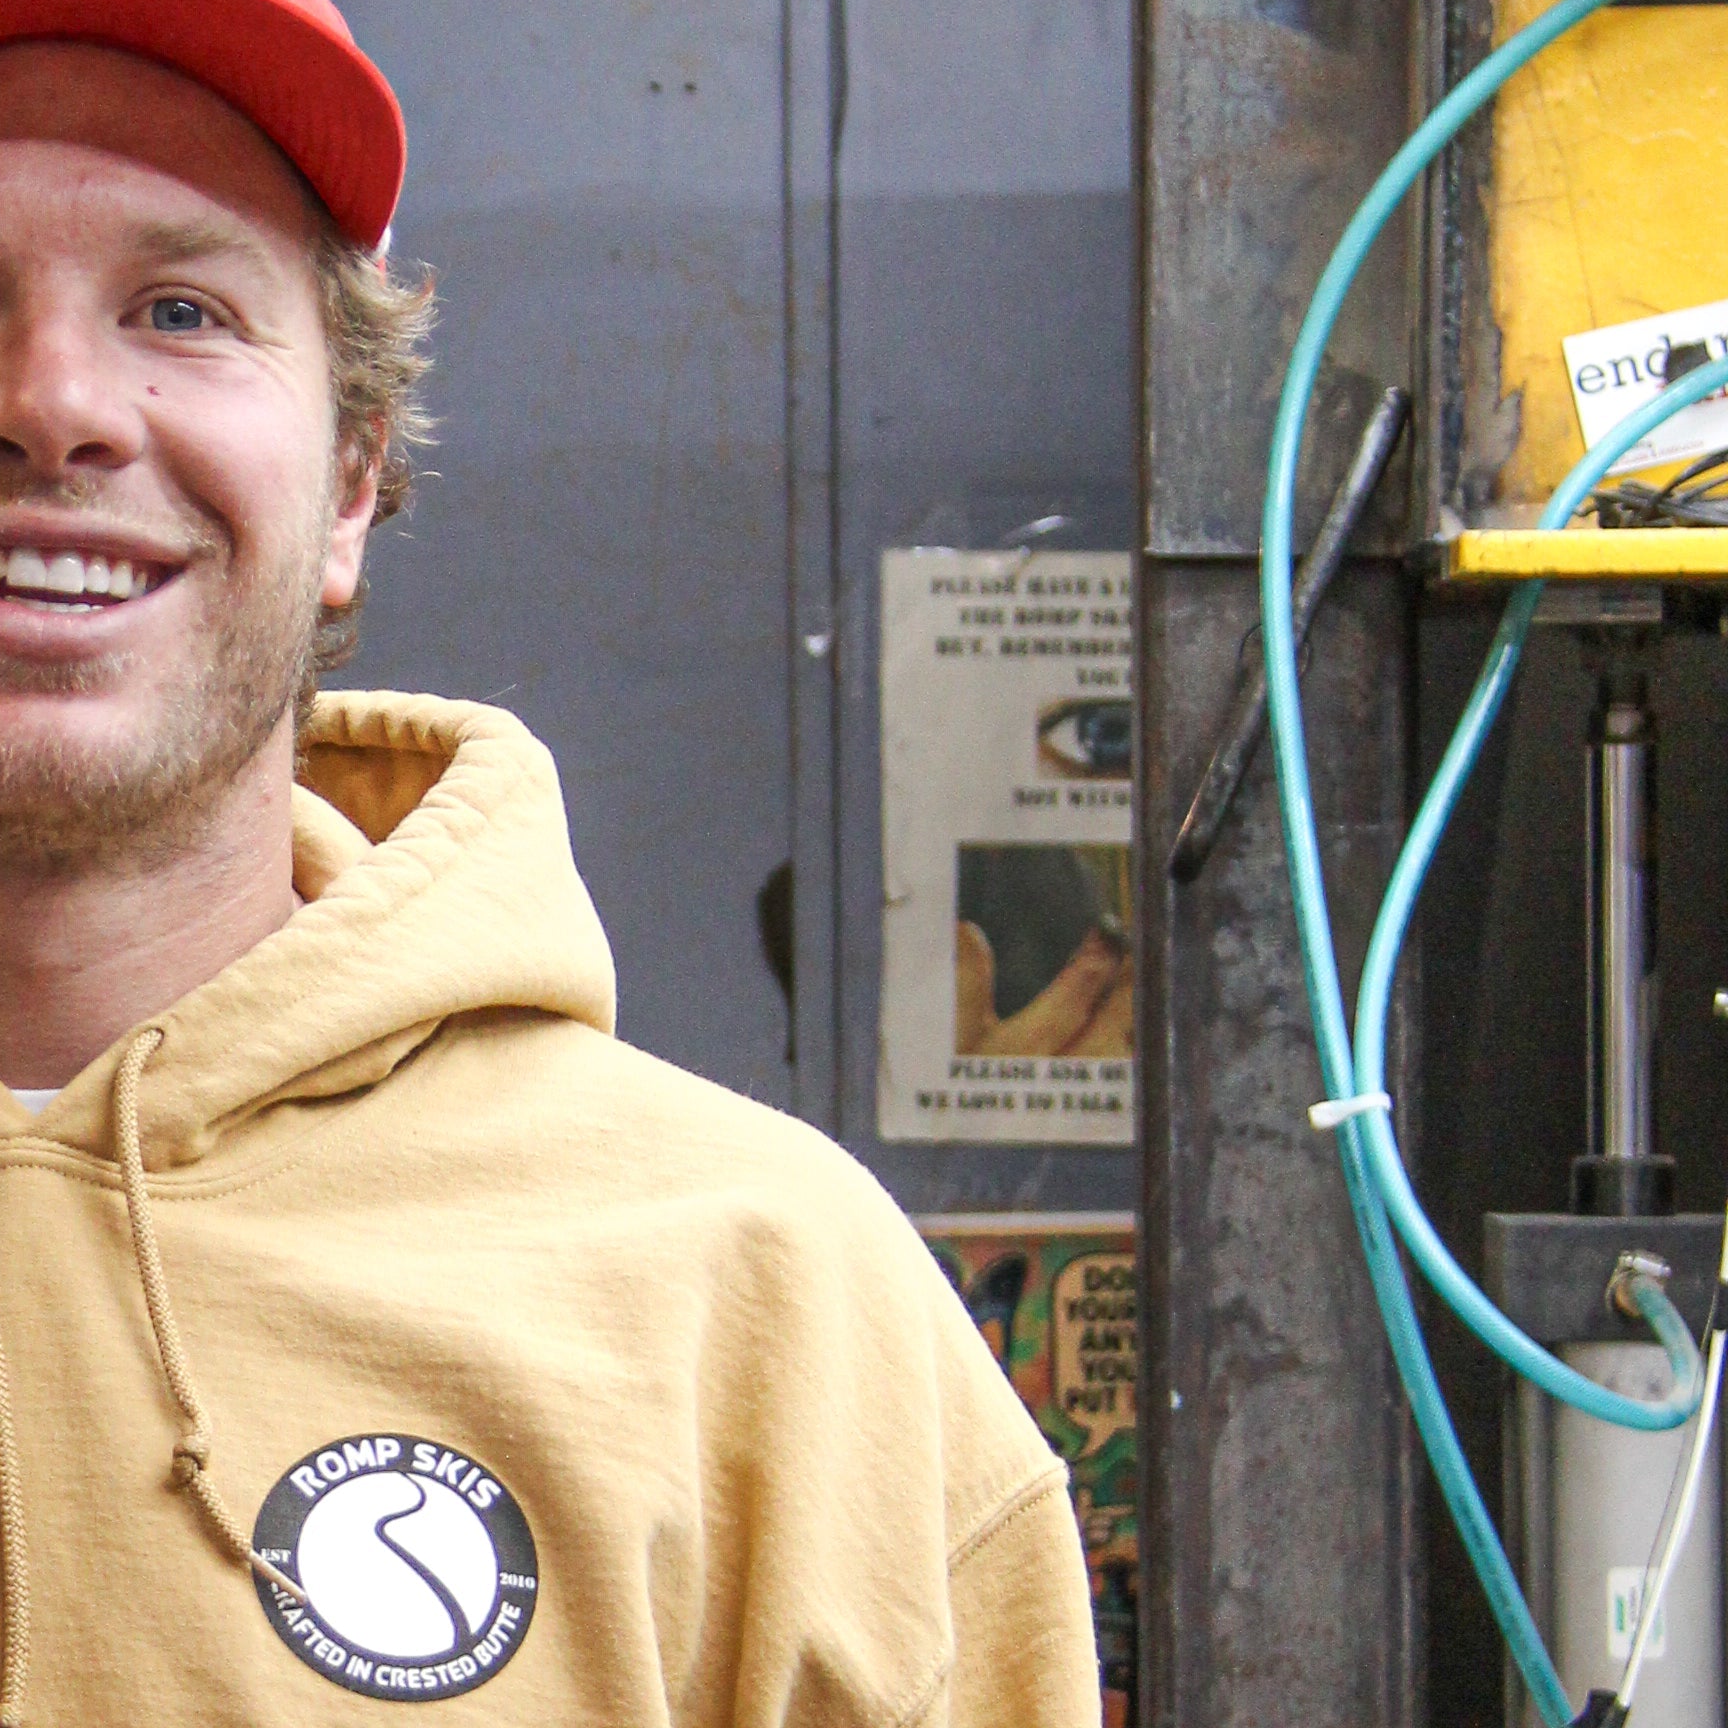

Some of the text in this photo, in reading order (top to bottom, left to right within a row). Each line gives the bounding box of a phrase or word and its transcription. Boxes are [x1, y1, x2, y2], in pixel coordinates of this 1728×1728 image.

[290, 1437, 503, 1511] ROMP SKIS
[260, 1548, 292, 1563] EST
[499, 1572, 537, 1590] 2010
[270, 1581, 522, 1690] RAFTED IN CRESTED BUTTE
